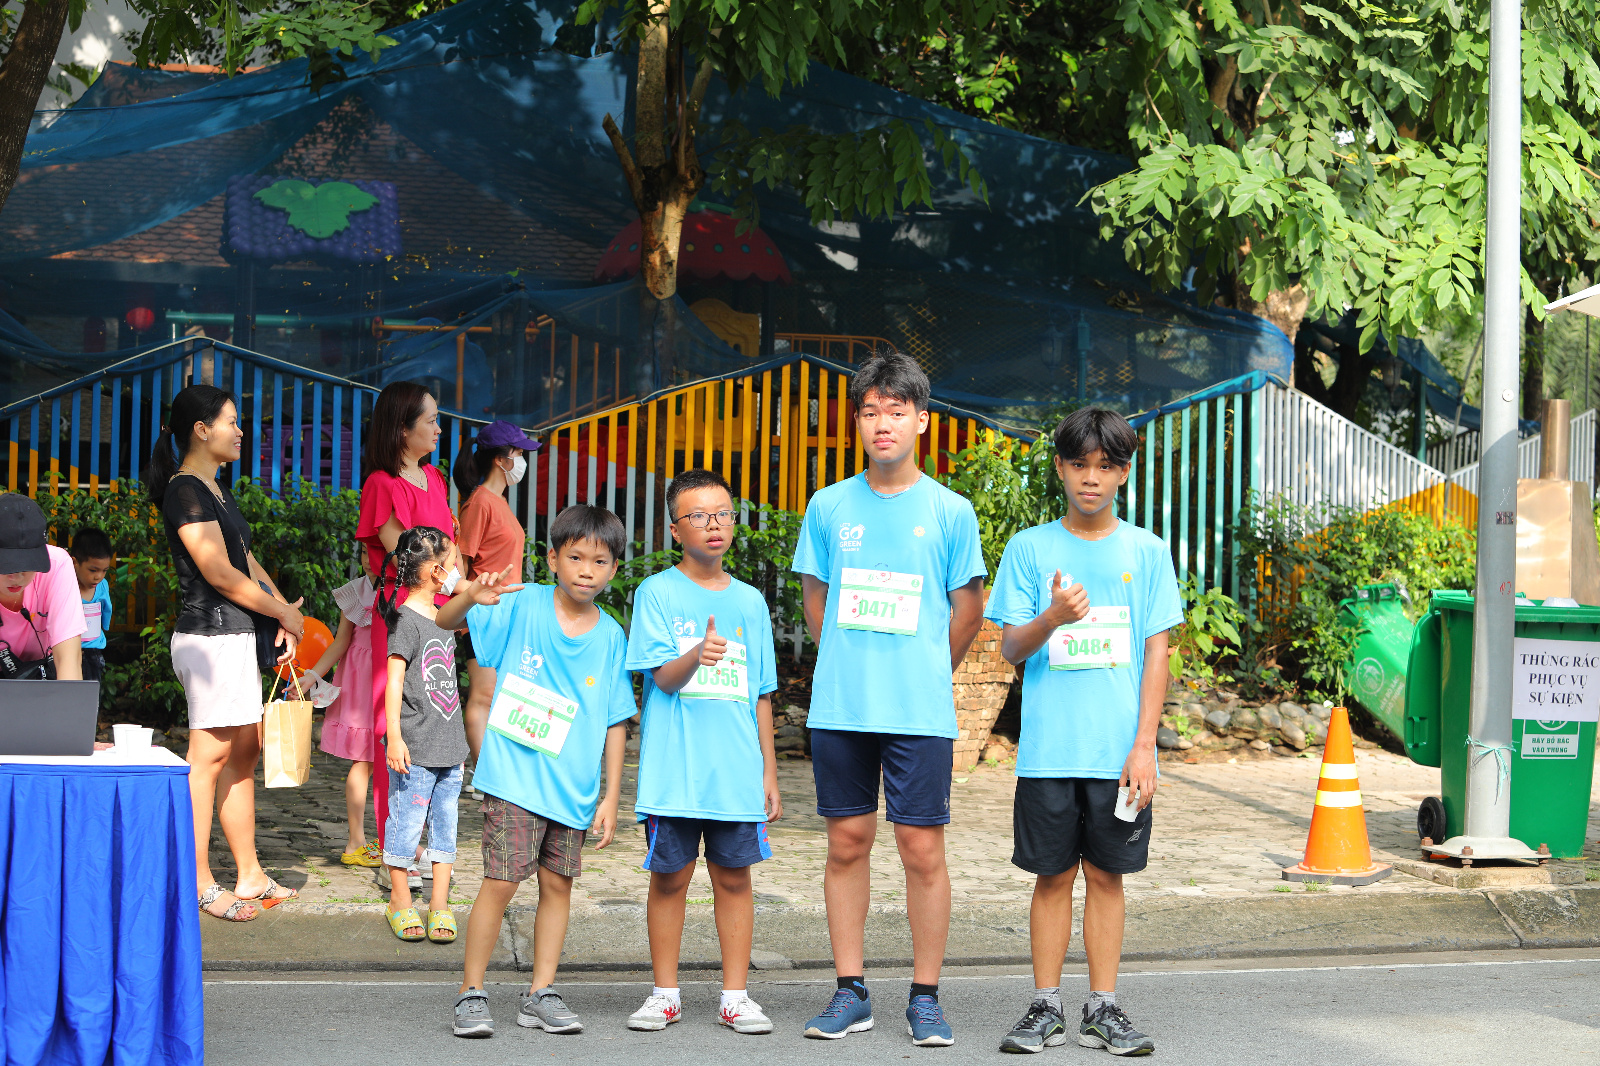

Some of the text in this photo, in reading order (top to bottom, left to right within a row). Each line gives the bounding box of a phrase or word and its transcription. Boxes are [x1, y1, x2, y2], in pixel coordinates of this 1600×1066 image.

[839, 524, 864, 540] GO
[840, 540, 862, 548] GREEN
[859, 599, 897, 619] 0471
[673, 621, 696, 636] GO
[1067, 638, 1112, 656] 0484
[520, 650, 543, 669] GO
[1520, 651, 1600, 669] THÙNG RÁC
[518, 663, 539, 677] GREEN
[697, 666, 739, 688] 0355
[424, 681, 438, 691] ALL
[1528, 672, 1588, 689] PHỤC VỤ
[1528, 690, 1584, 707] SỰ KIỆN
[507, 708, 551, 739] 0459
